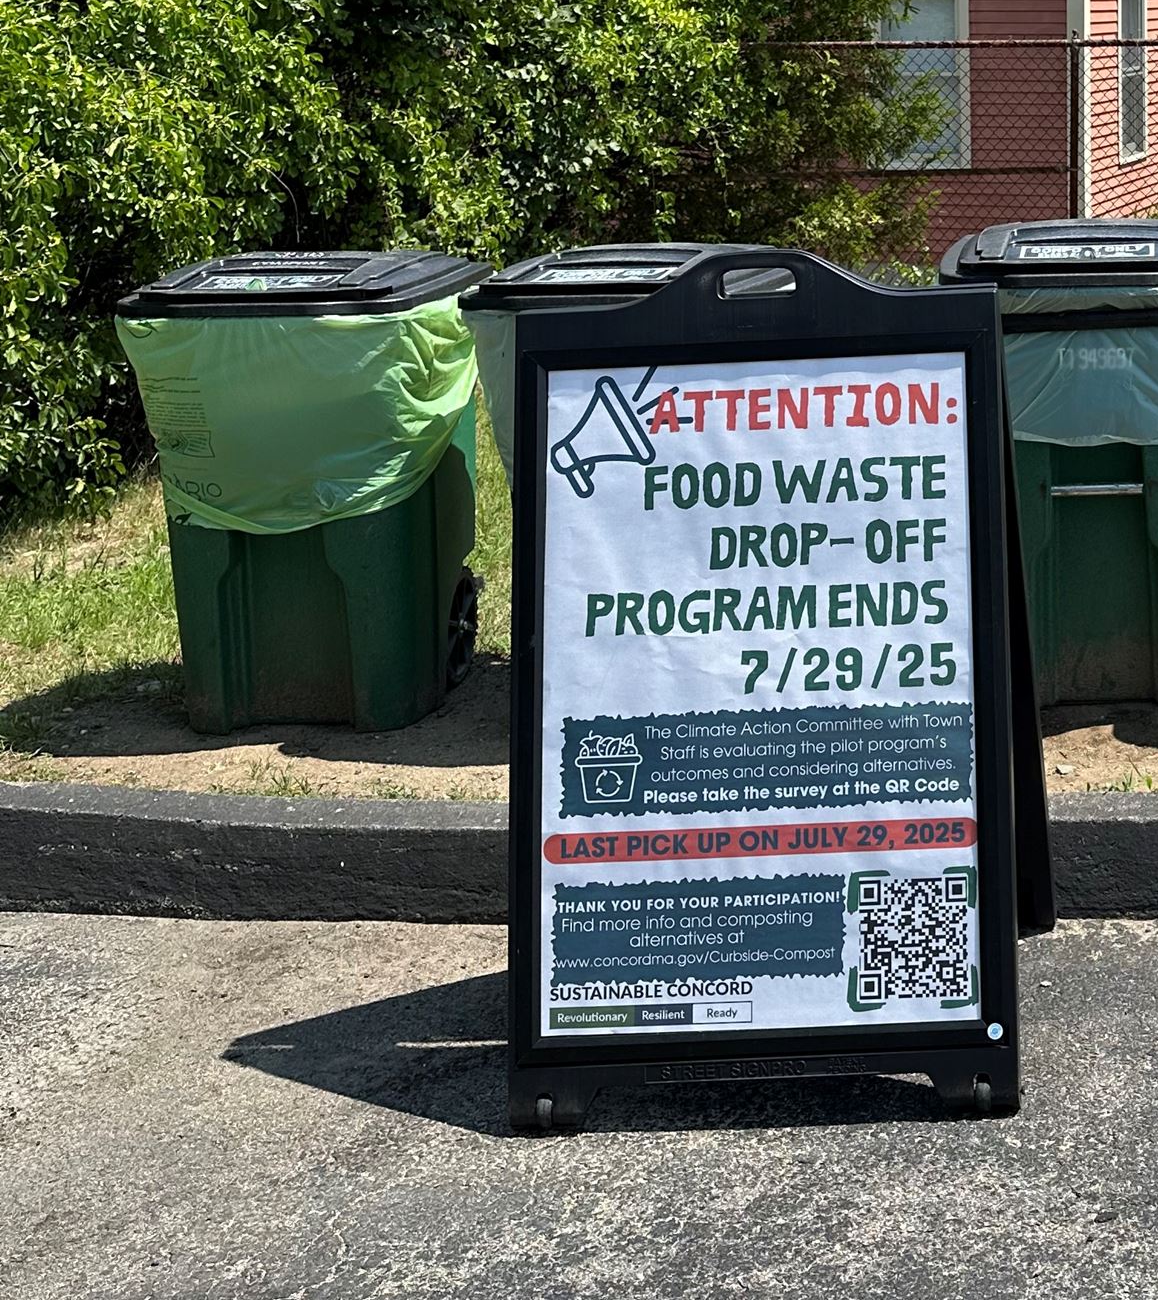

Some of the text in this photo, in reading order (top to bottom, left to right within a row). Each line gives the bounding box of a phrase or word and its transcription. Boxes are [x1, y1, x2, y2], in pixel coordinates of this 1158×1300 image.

[648, 381, 959, 435] ATTENTION:
[643, 454, 947, 511] FOOD WASTE
[584, 579, 949, 637] PROGRAM ENDS
[739, 642, 957, 695] 7/29/25
[644, 713, 963, 739] The Climate Action Committee with Town
[660, 734, 947, 760] Staff is evaluating the pilot program's
[650, 756, 957, 782] outcomes and considering alternatives.
[643, 776, 960, 804] Please take the survey at the QR Code
[559, 820, 966, 860] LAST PICK UP ON JULY 29, 2025
[557, 890, 840, 914] THANK YOU FOR YOUR PARTICIPATION!
[561, 909, 813, 933] Find more info and composting
[629, 929, 745, 948] alternatives at
[555, 946, 836, 969] www.concordma.gov/Curbside-Compost
[549, 980, 753, 1002] SUSTAINABLE CONCORD
[557, 1010, 628, 1025] Revolutionary
[641, 1008, 685, 1021] Resilient
[706, 1006, 738, 1021] Ready
[660, 1064, 724, 1080] STREET
